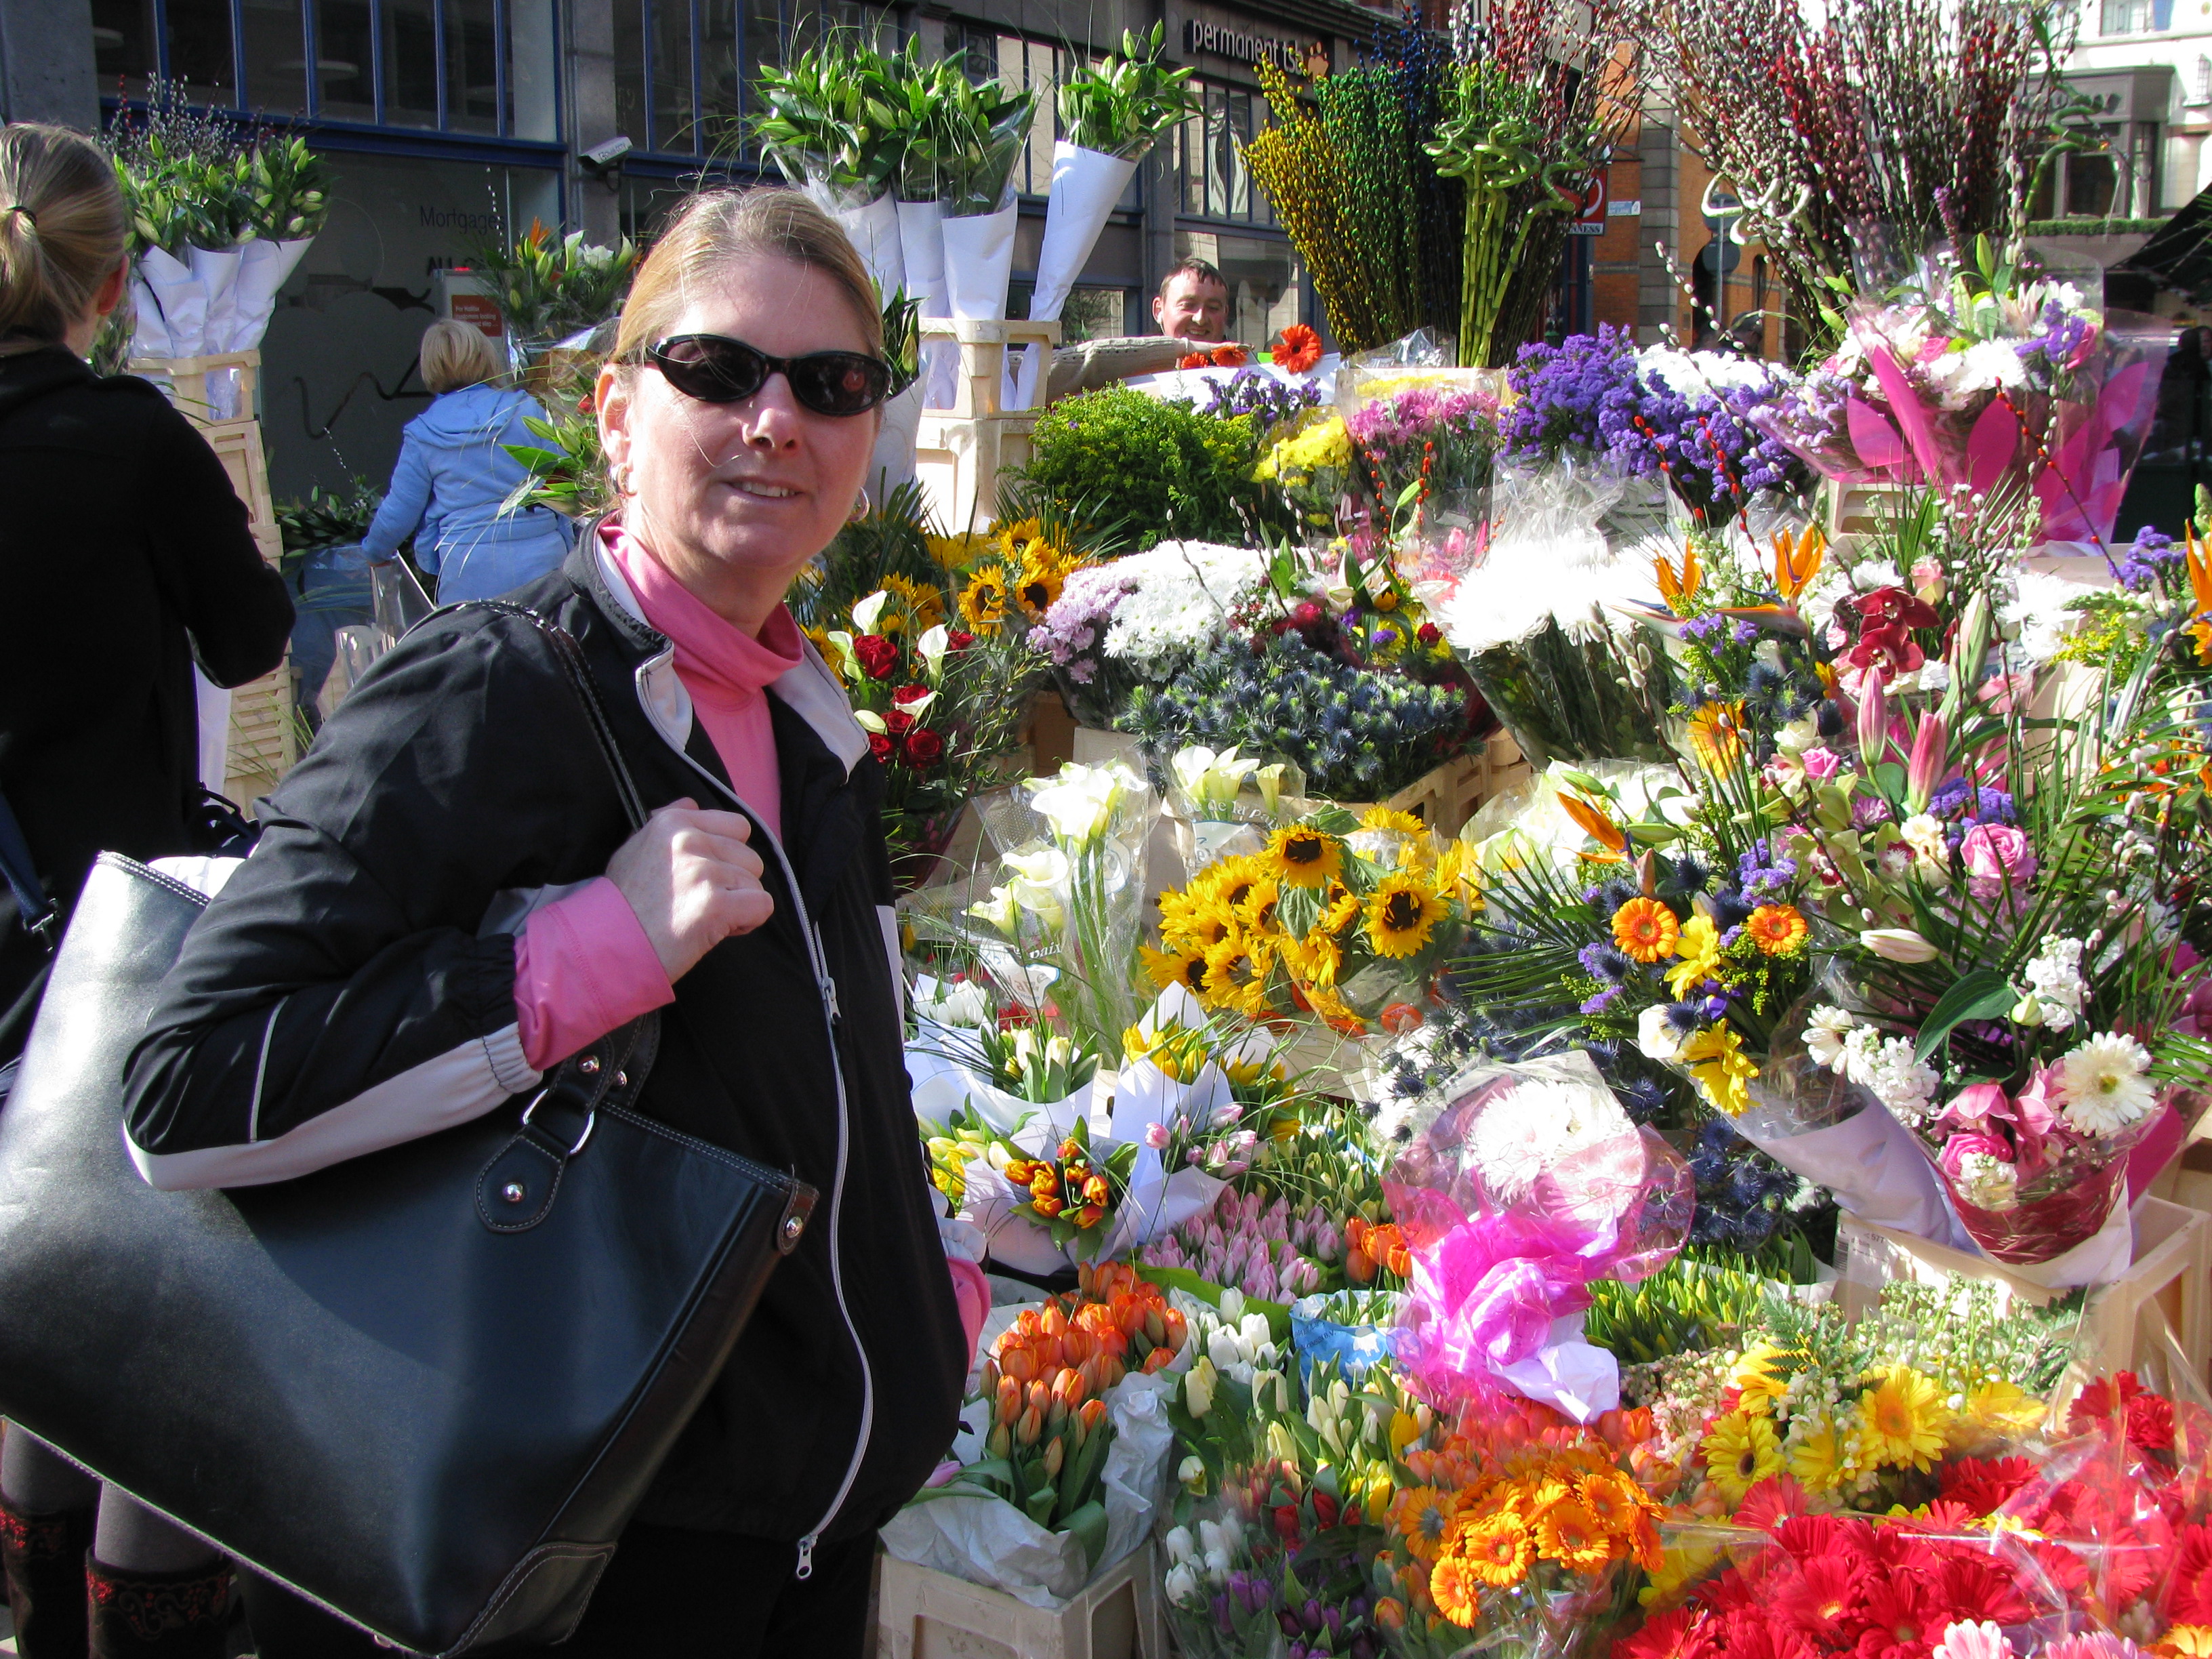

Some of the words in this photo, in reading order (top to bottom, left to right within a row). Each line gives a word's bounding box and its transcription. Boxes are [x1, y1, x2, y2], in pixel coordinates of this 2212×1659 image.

[1193, 20, 1279, 68] permanent
[1282, 41, 1305, 75] tsb
[420, 205, 506, 234] Mortgages
[1208, 799, 1227, 812] de
[1231, 800, 1246, 815] la
[1029, 941, 1061, 959] paix
